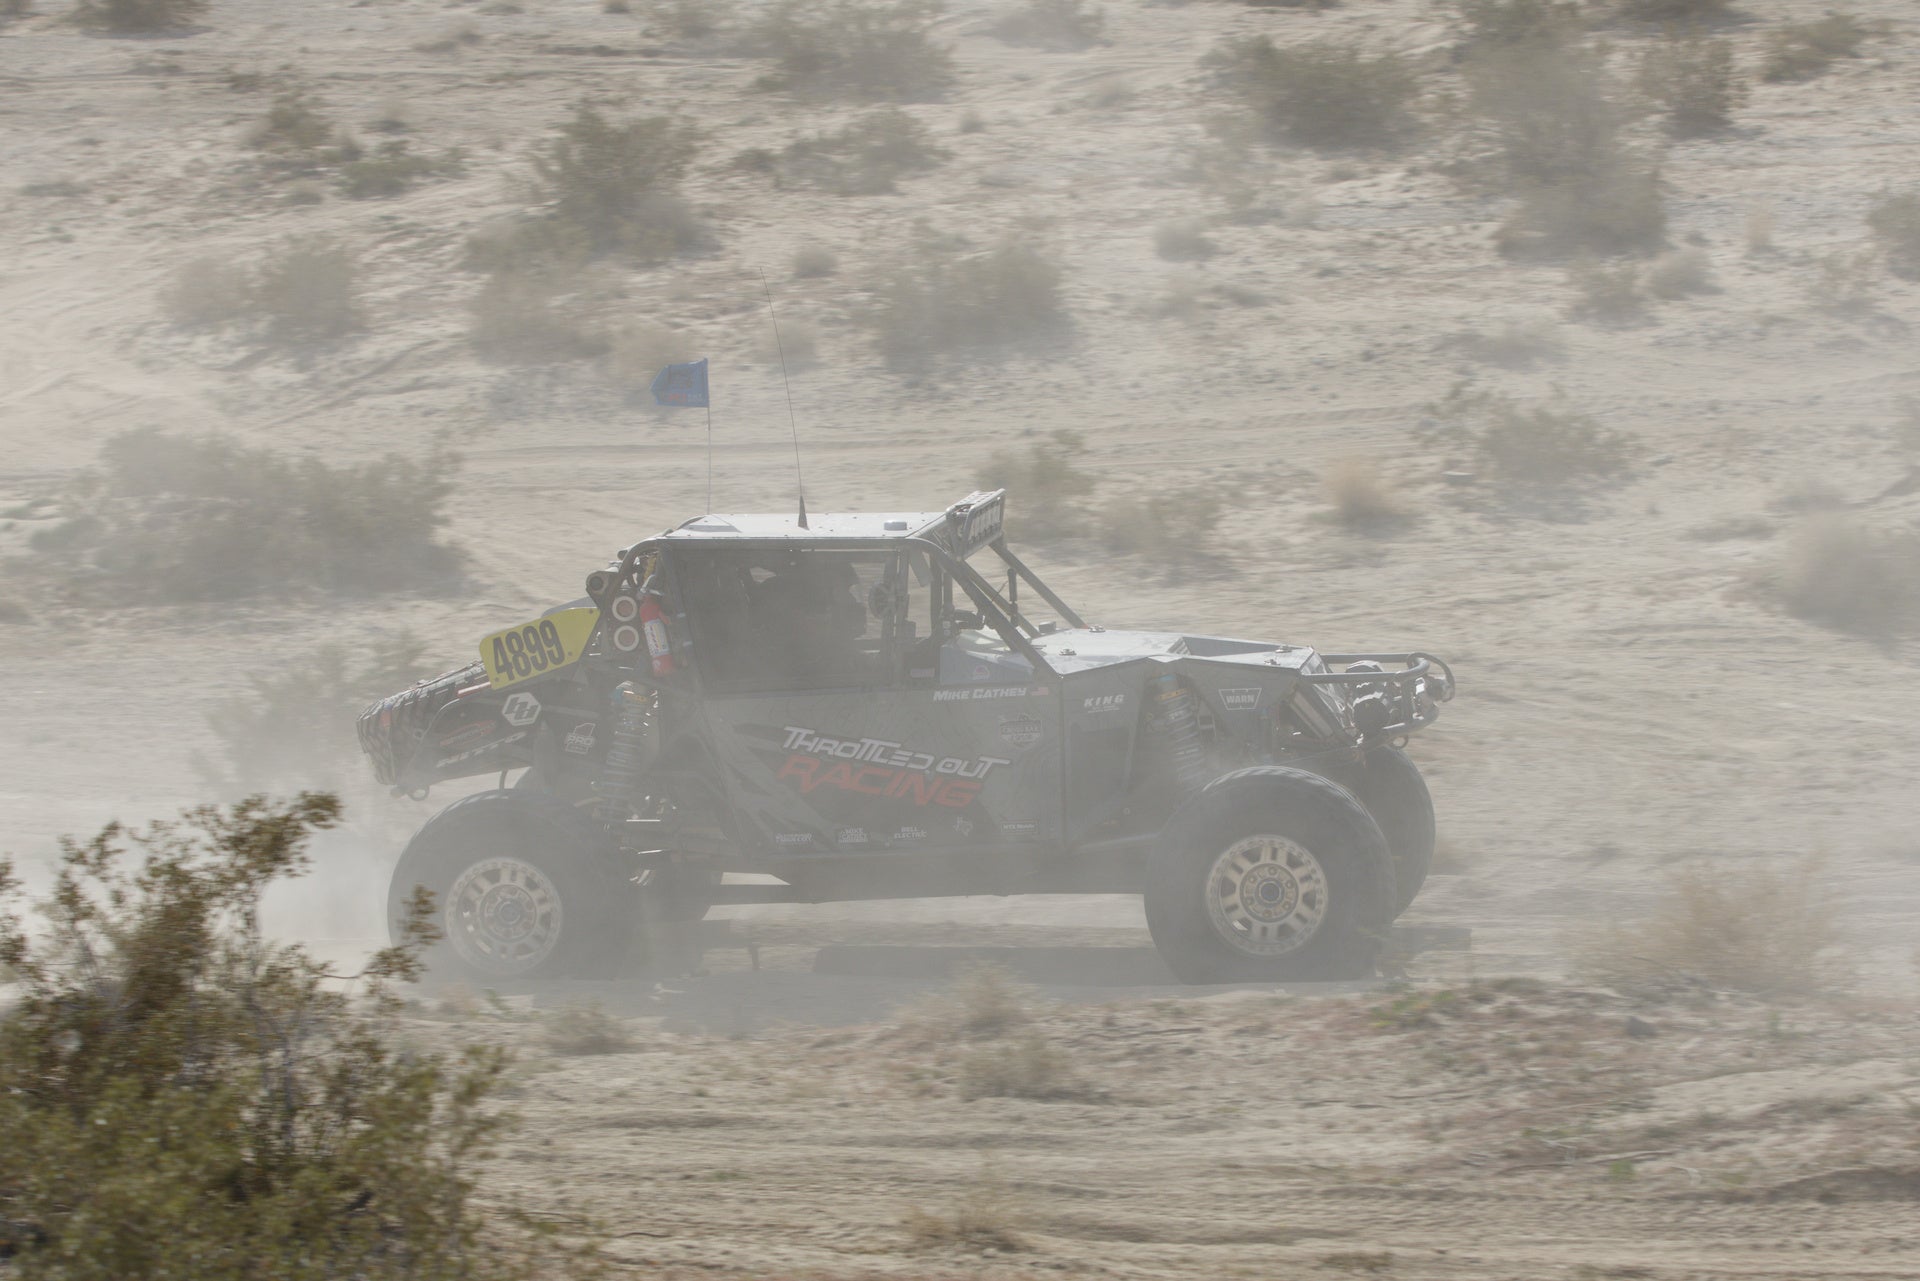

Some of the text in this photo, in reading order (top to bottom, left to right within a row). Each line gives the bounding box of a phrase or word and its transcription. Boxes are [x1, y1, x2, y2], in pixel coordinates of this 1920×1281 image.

[492, 620, 565, 682] 4899
[933, 687, 1027, 702] MIKE CATHEY
[1083, 694, 1125, 708] KING
[1226, 694, 1255, 704] WARN
[781, 725, 1011, 779] THROTTLED OUT
[776, 755, 984, 808] RACING
